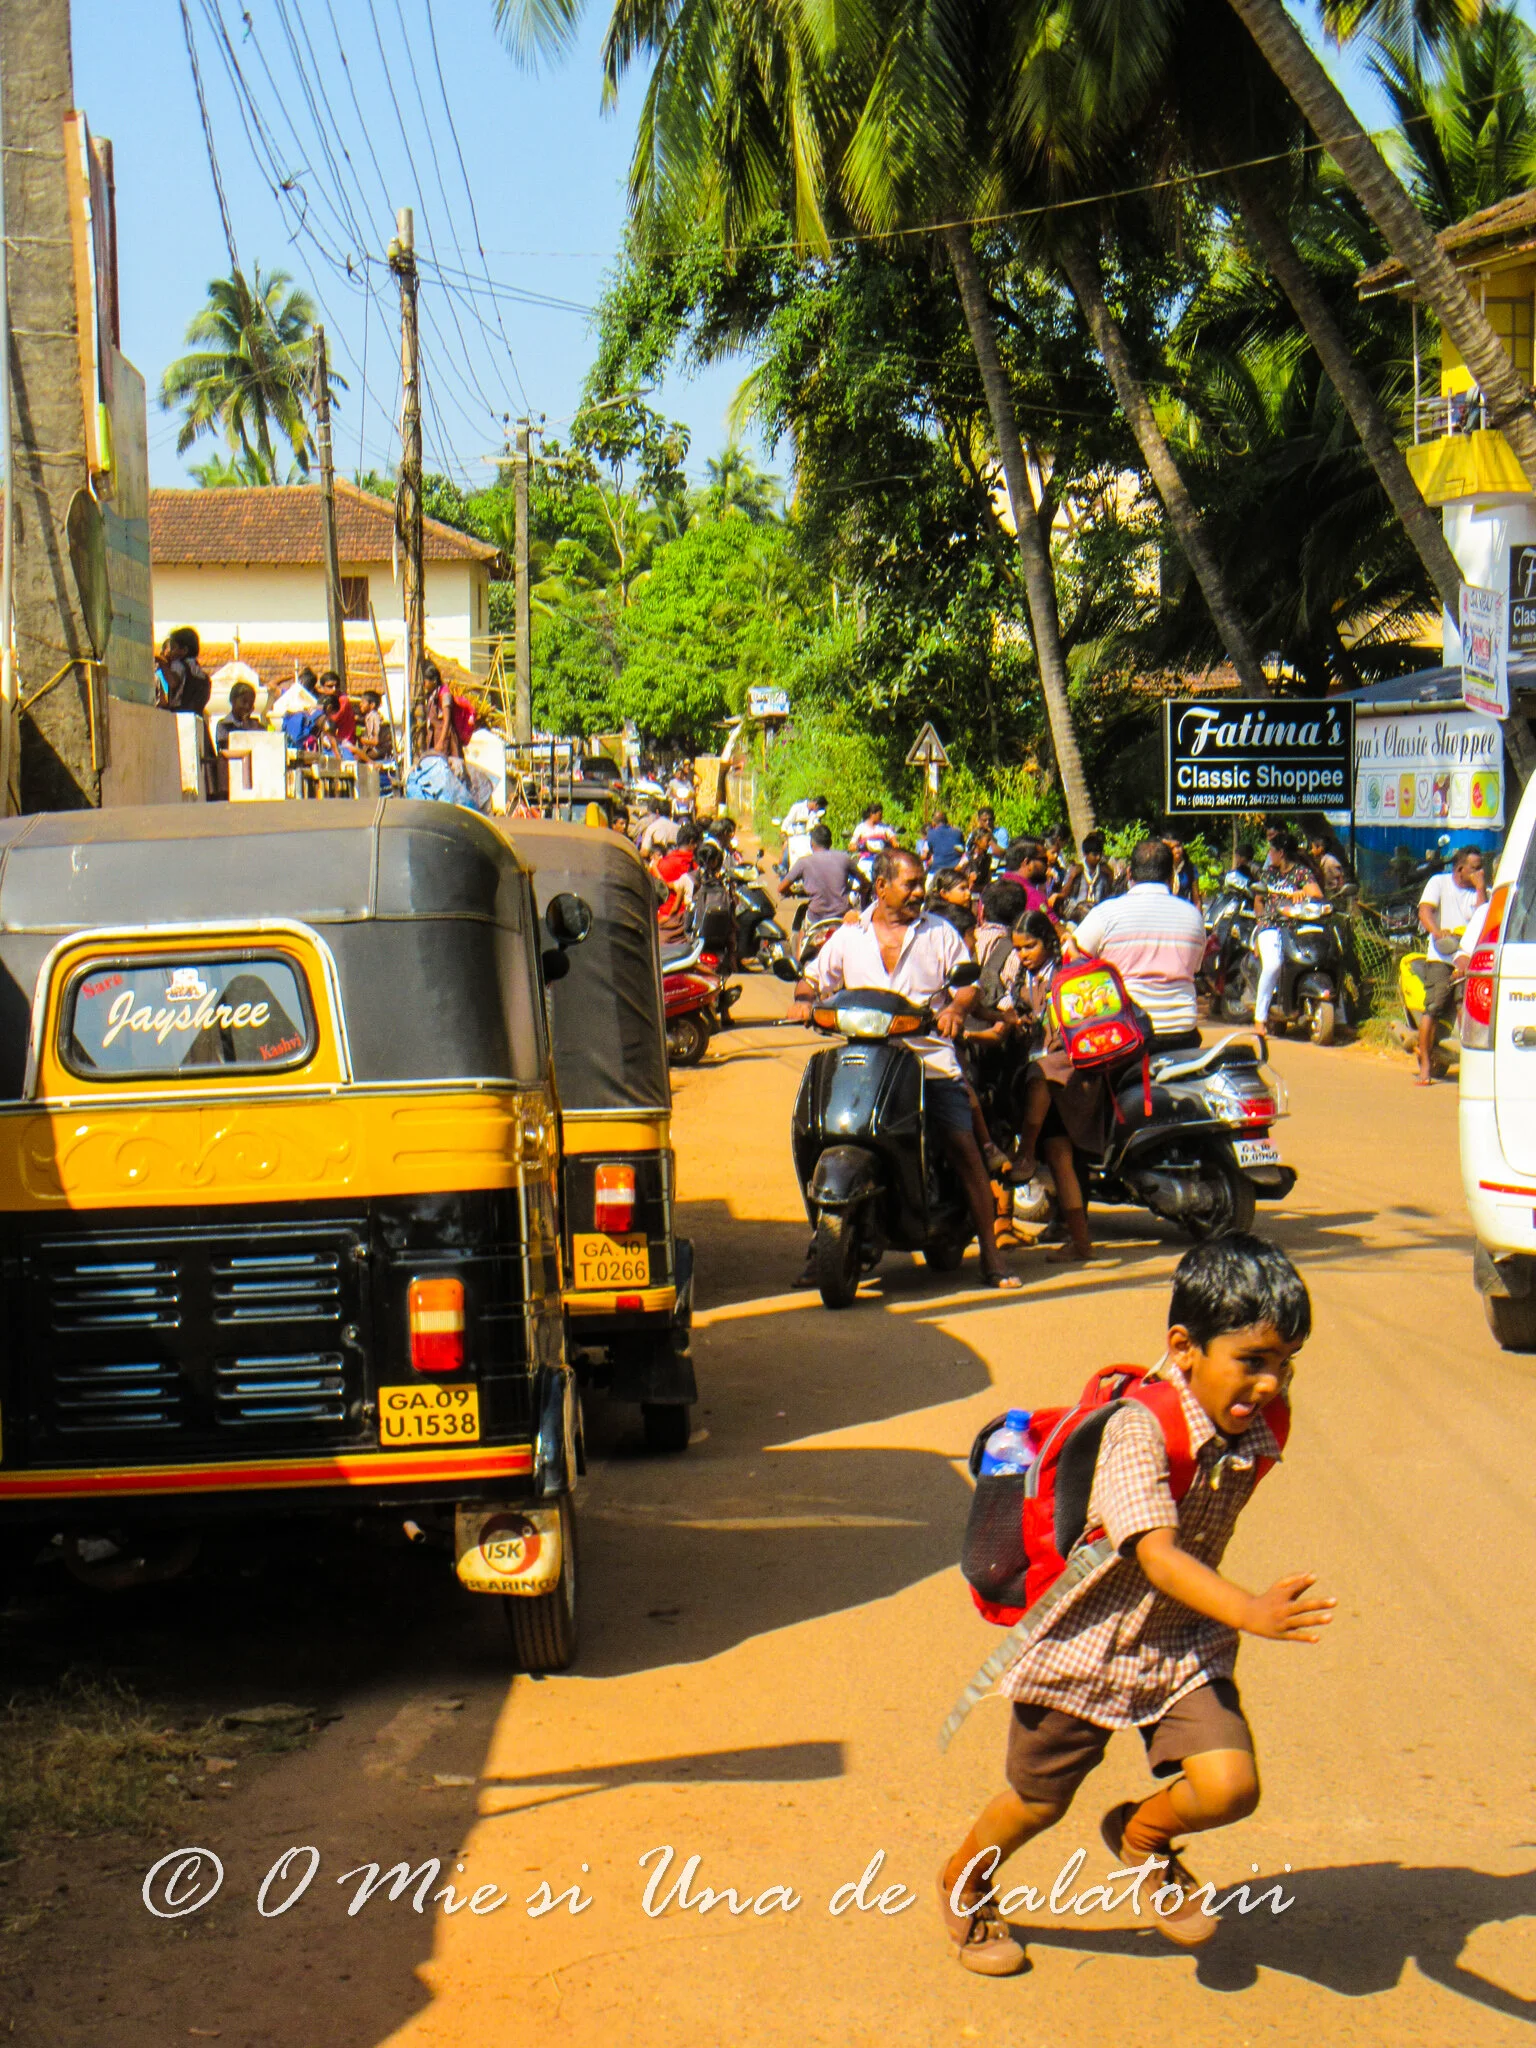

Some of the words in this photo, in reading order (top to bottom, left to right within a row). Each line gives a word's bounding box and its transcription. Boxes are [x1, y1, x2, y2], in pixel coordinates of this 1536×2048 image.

[1178, 706, 1345, 757] Fatima's
[1384, 723, 1428, 759] Classic
[1431, 721, 1496, 763] Shoppee
[1177, 764, 1251, 789] Classic
[1256, 764, 1343, 793] Shoppee
[1192, 794, 1215, 808] (0832)
[102, 988, 271, 1049] Jayshree
[579, 1261, 646, 1282] T.0266
[387, 1390, 470, 1411] GA.09
[385, 1413, 476, 1438] U.1538
[487, 1542, 522, 1560] ISK
